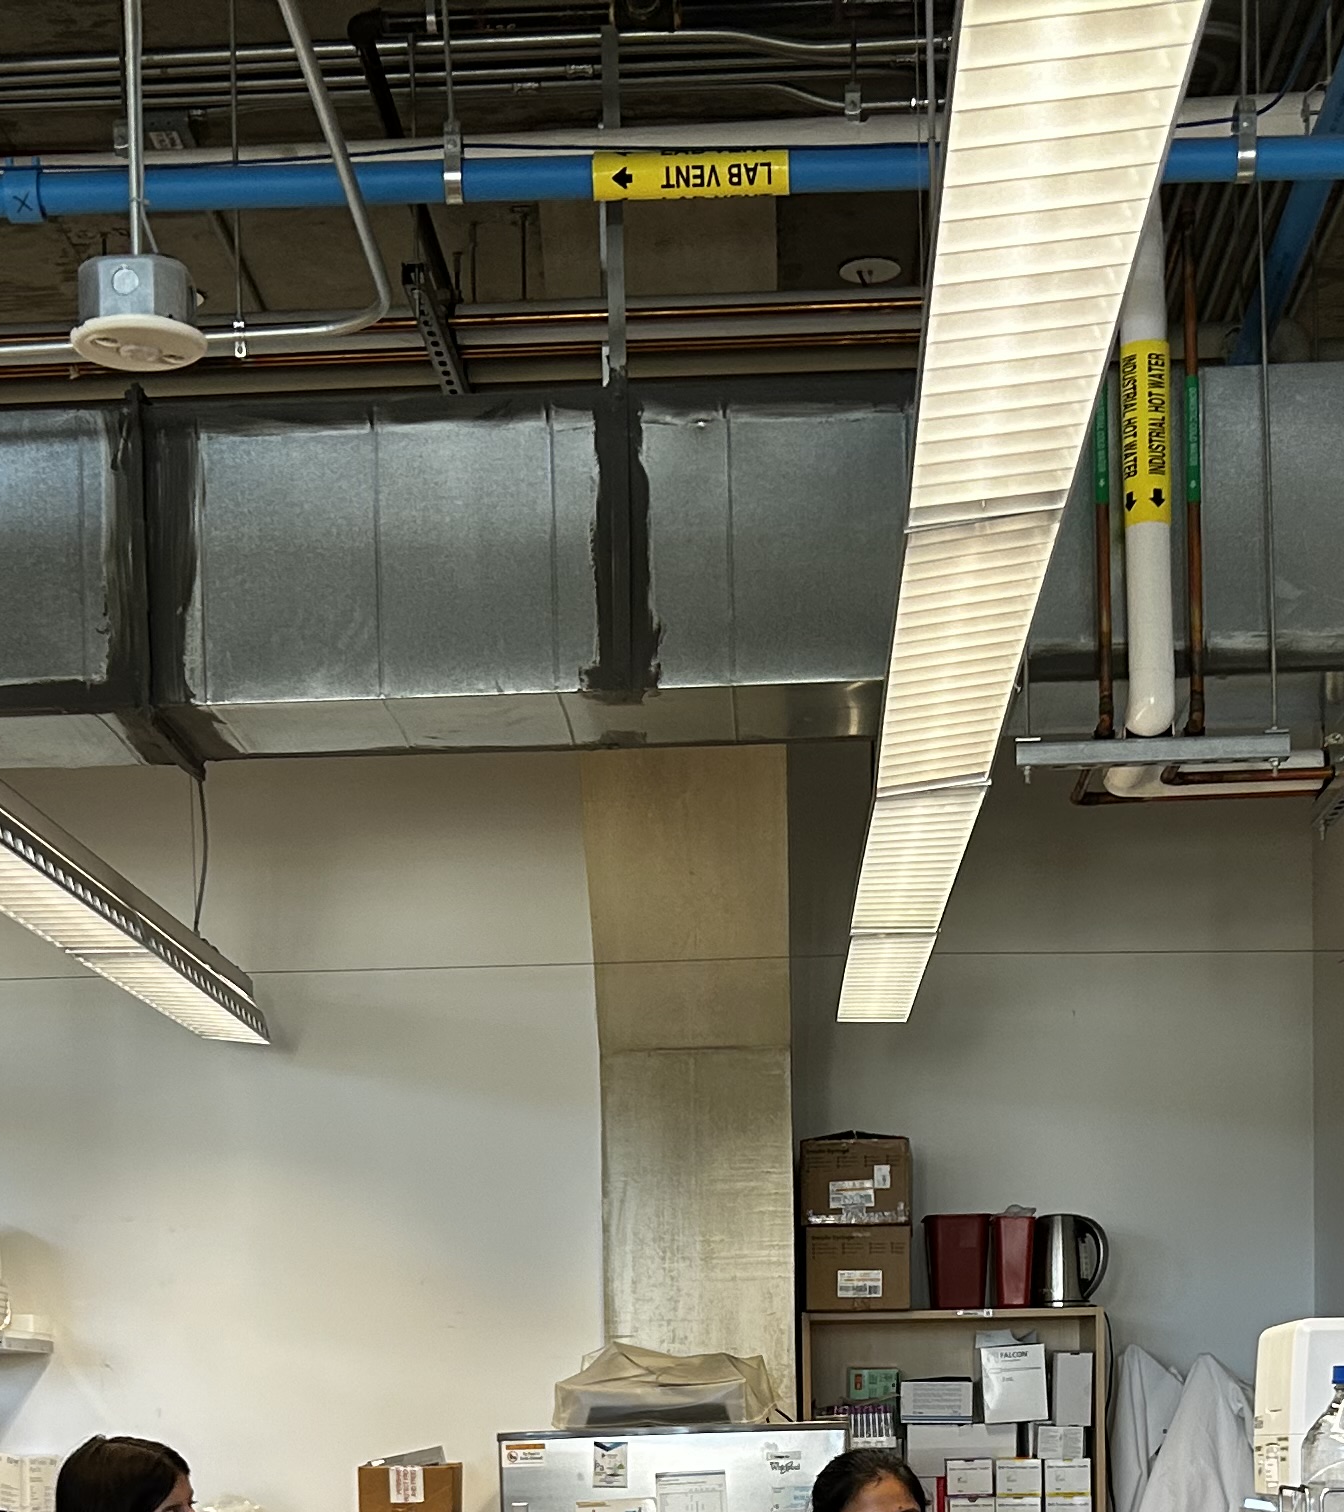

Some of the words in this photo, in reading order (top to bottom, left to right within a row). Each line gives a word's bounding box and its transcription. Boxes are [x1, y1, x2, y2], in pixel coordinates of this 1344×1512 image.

[661, 164, 720, 188] VENT
[728, 161, 772, 186] LAB
[1122, 354, 1137, 413] INDUSTRIAL
[1148, 353, 1166, 389] WATER
[1148, 390, 1166, 414] HOT
[1123, 415, 1137, 438] HOT
[1148, 416, 1166, 475] INDUSTRIAL
[1124, 439, 1137, 480] WATER
[1000, 1350, 1028, 1359] FALCON
